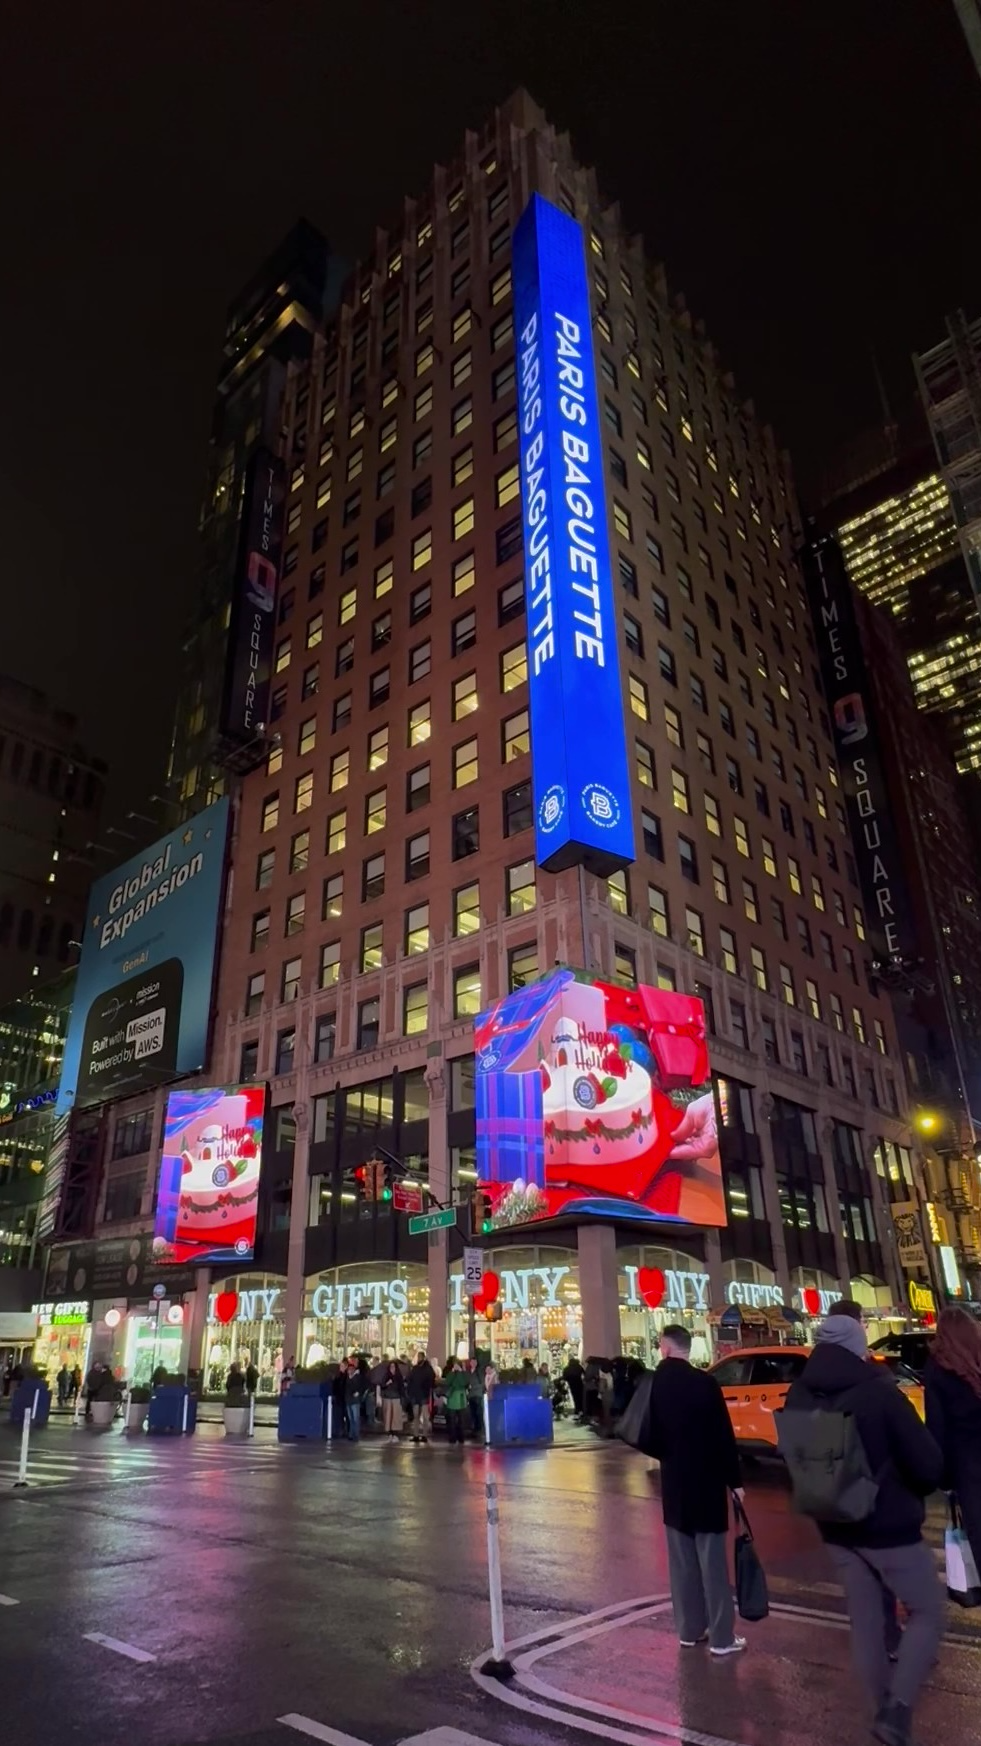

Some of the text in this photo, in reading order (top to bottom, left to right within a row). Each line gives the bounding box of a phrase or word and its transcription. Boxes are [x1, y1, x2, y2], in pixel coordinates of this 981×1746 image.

[261, 467, 275, 551] TIMES
[520, 311, 555, 676] PARIS BAGUETTE
[554, 311, 605, 667] PARIS BAGUETTE
[244, 614, 262, 729] SQUARE
[813, 550, 848, 681] TIMES
[852, 757, 899, 953] SQUARE
[108, 843, 172, 915] Global
[100, 852, 203, 950] Expansion
[122, 951, 149, 974] GenAI
[89, 1034, 161, 1076] Powered by AWS.
[91, 1015, 163, 1055] Built with Mission.
[423, 1218, 429, 1228] 7
[450, 1266, 570, 1311] I NY
[467, 1266, 482, 1280] 25
[624, 1265, 710, 1310] I NY
[727, 1281, 785, 1308] GIFTS
[54, 1301, 88, 1315] GIFTS
[207, 1288, 280, 1322] I NY
[312, 1279, 409, 1317] GIFTS
